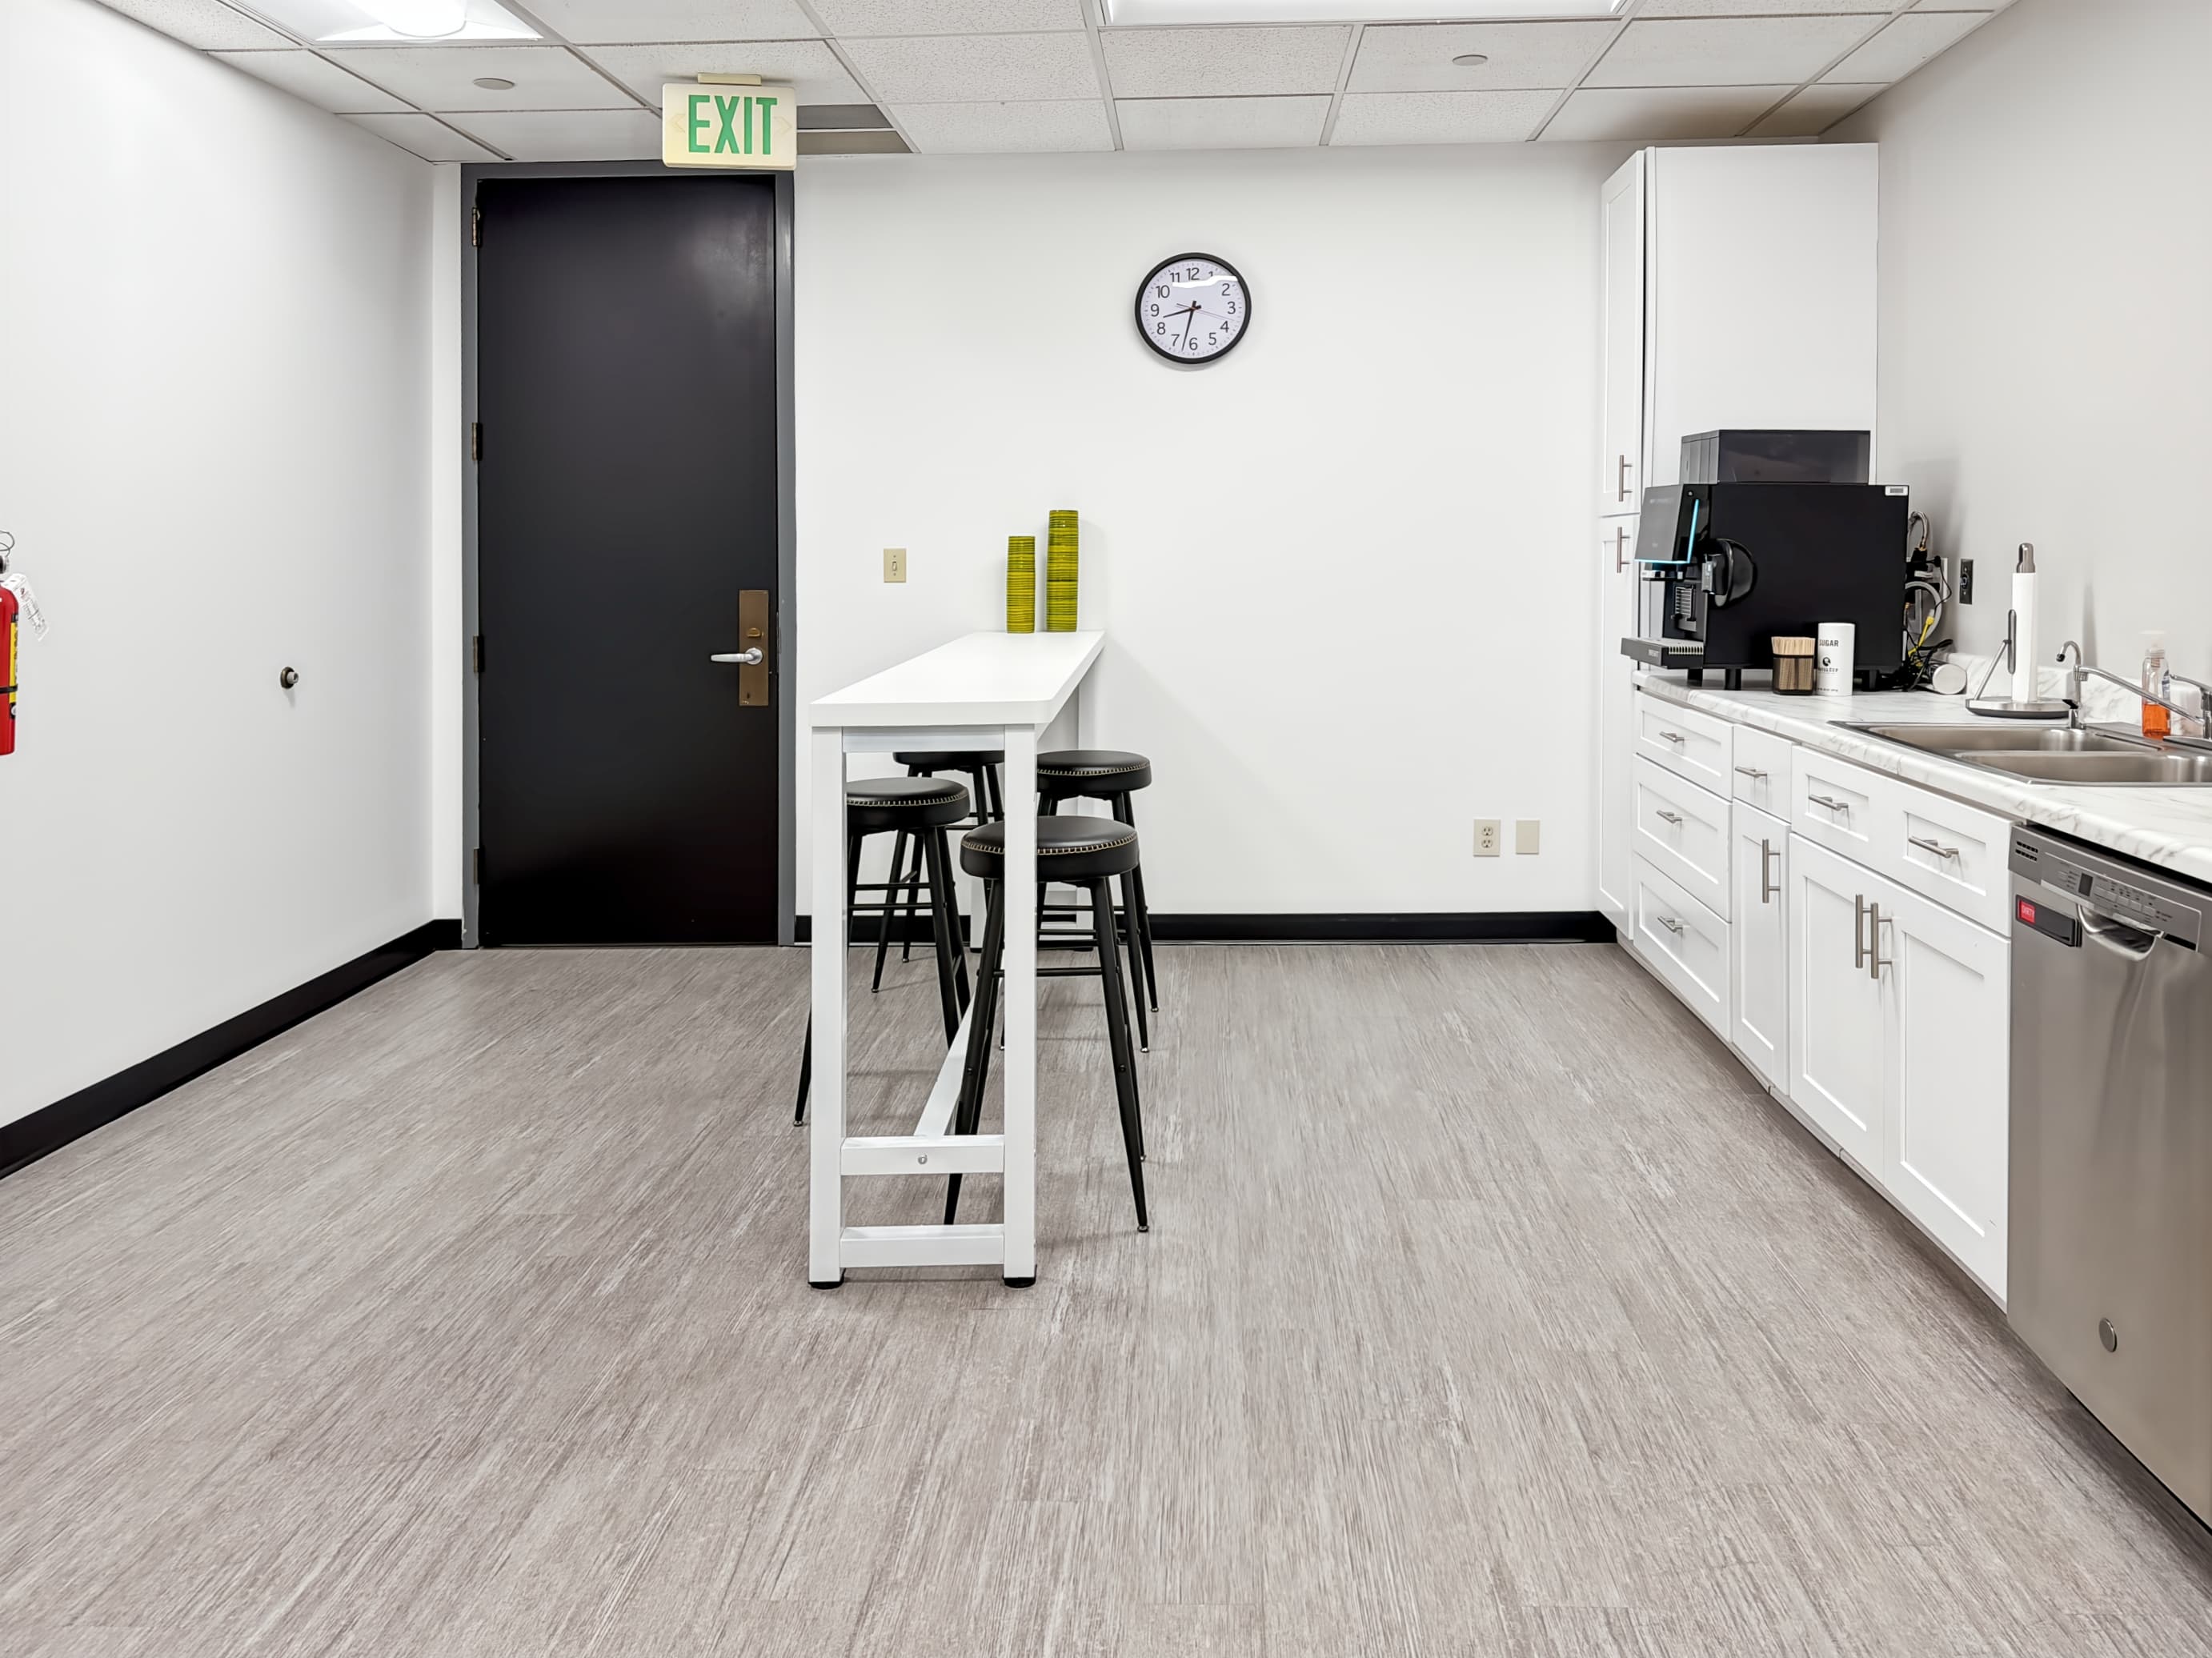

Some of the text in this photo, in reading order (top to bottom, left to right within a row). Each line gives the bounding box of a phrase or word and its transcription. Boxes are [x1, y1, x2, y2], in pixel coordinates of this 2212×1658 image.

[688, 94, 778, 155] EXIT
[1170, 272, 1180, 283] 11
[1186, 267, 1200, 281] 12
[1156, 285, 1170, 298] 10
[1221, 283, 1230, 296] 2
[1150, 303, 1160, 317] 9
[1227, 301, 1236, 314] 3
[1156, 322, 1166, 335] 8
[1220, 320, 1229, 333] 4
[1171, 334, 1180, 346] 7
[1188, 337, 1198, 350] 6
[1208, 332, 1217, 346] 5
